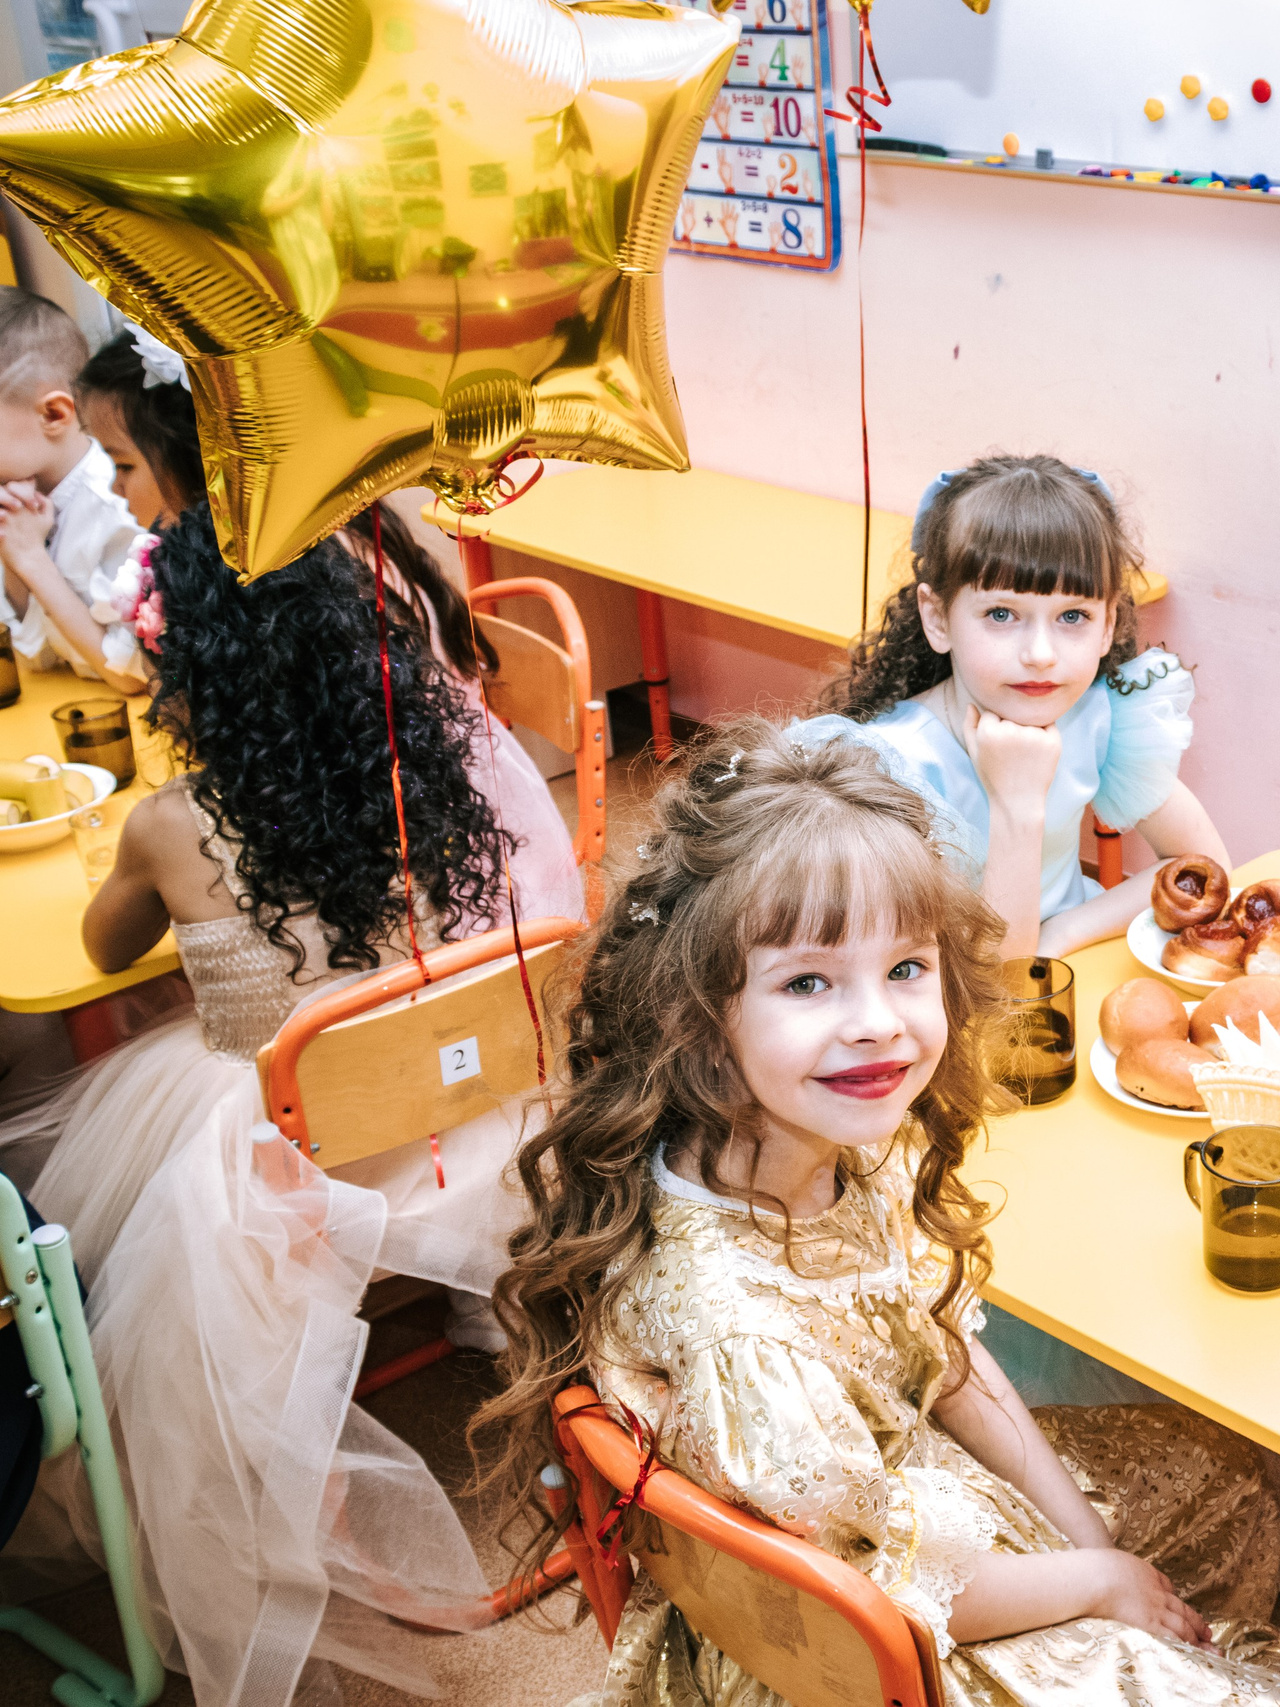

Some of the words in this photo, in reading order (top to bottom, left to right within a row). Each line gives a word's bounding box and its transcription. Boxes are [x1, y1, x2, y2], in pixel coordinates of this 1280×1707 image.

[769, 38, 789, 81] 4
[770, 96, 801, 138] 10
[778, 153, 798, 194] 2
[782, 208, 802, 249] 8
[452, 1049, 467, 1071] 2
